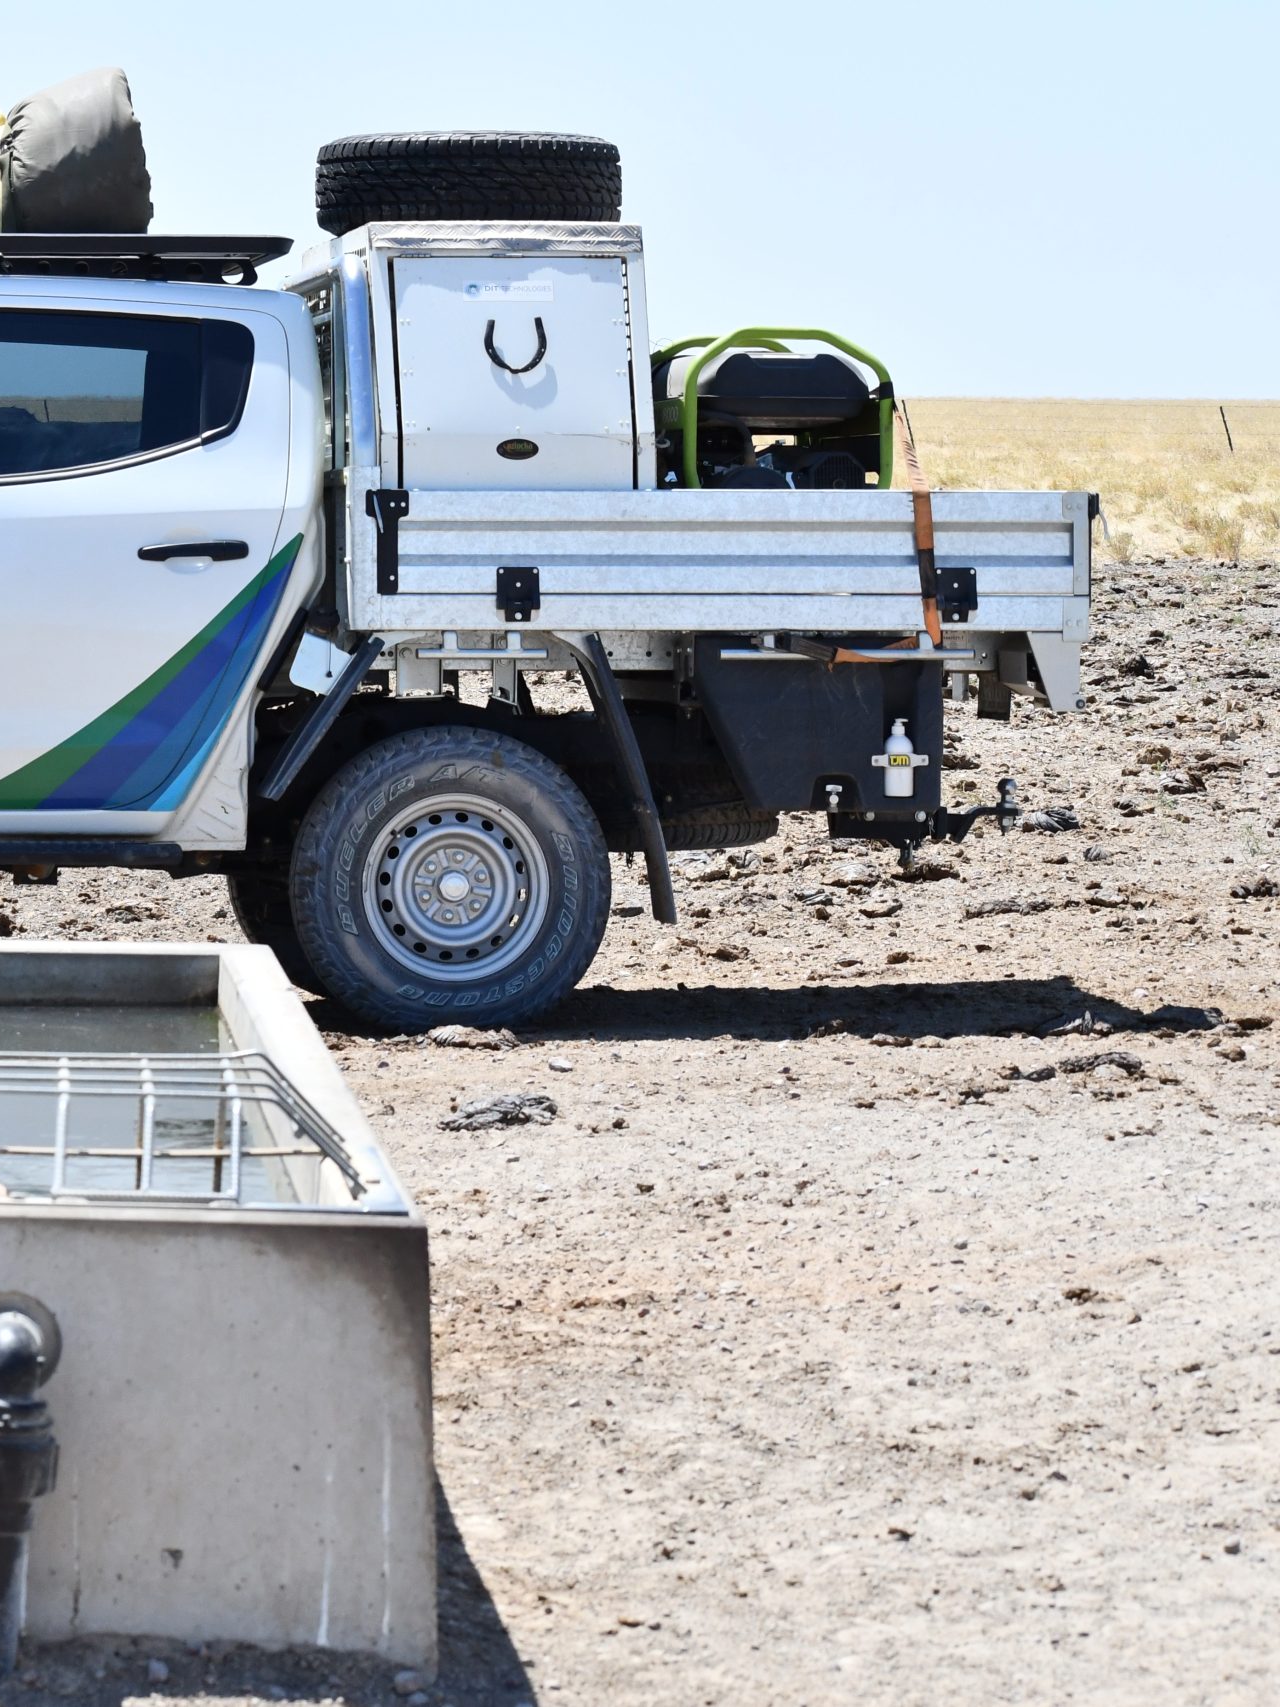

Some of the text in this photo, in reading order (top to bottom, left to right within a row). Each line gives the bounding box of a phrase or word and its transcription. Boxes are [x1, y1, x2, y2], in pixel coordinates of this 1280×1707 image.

[889, 755, 910, 766] TJM
[334, 763, 507, 936] DUELER A/T
[397, 831, 580, 1007] BRIDGESTONE
